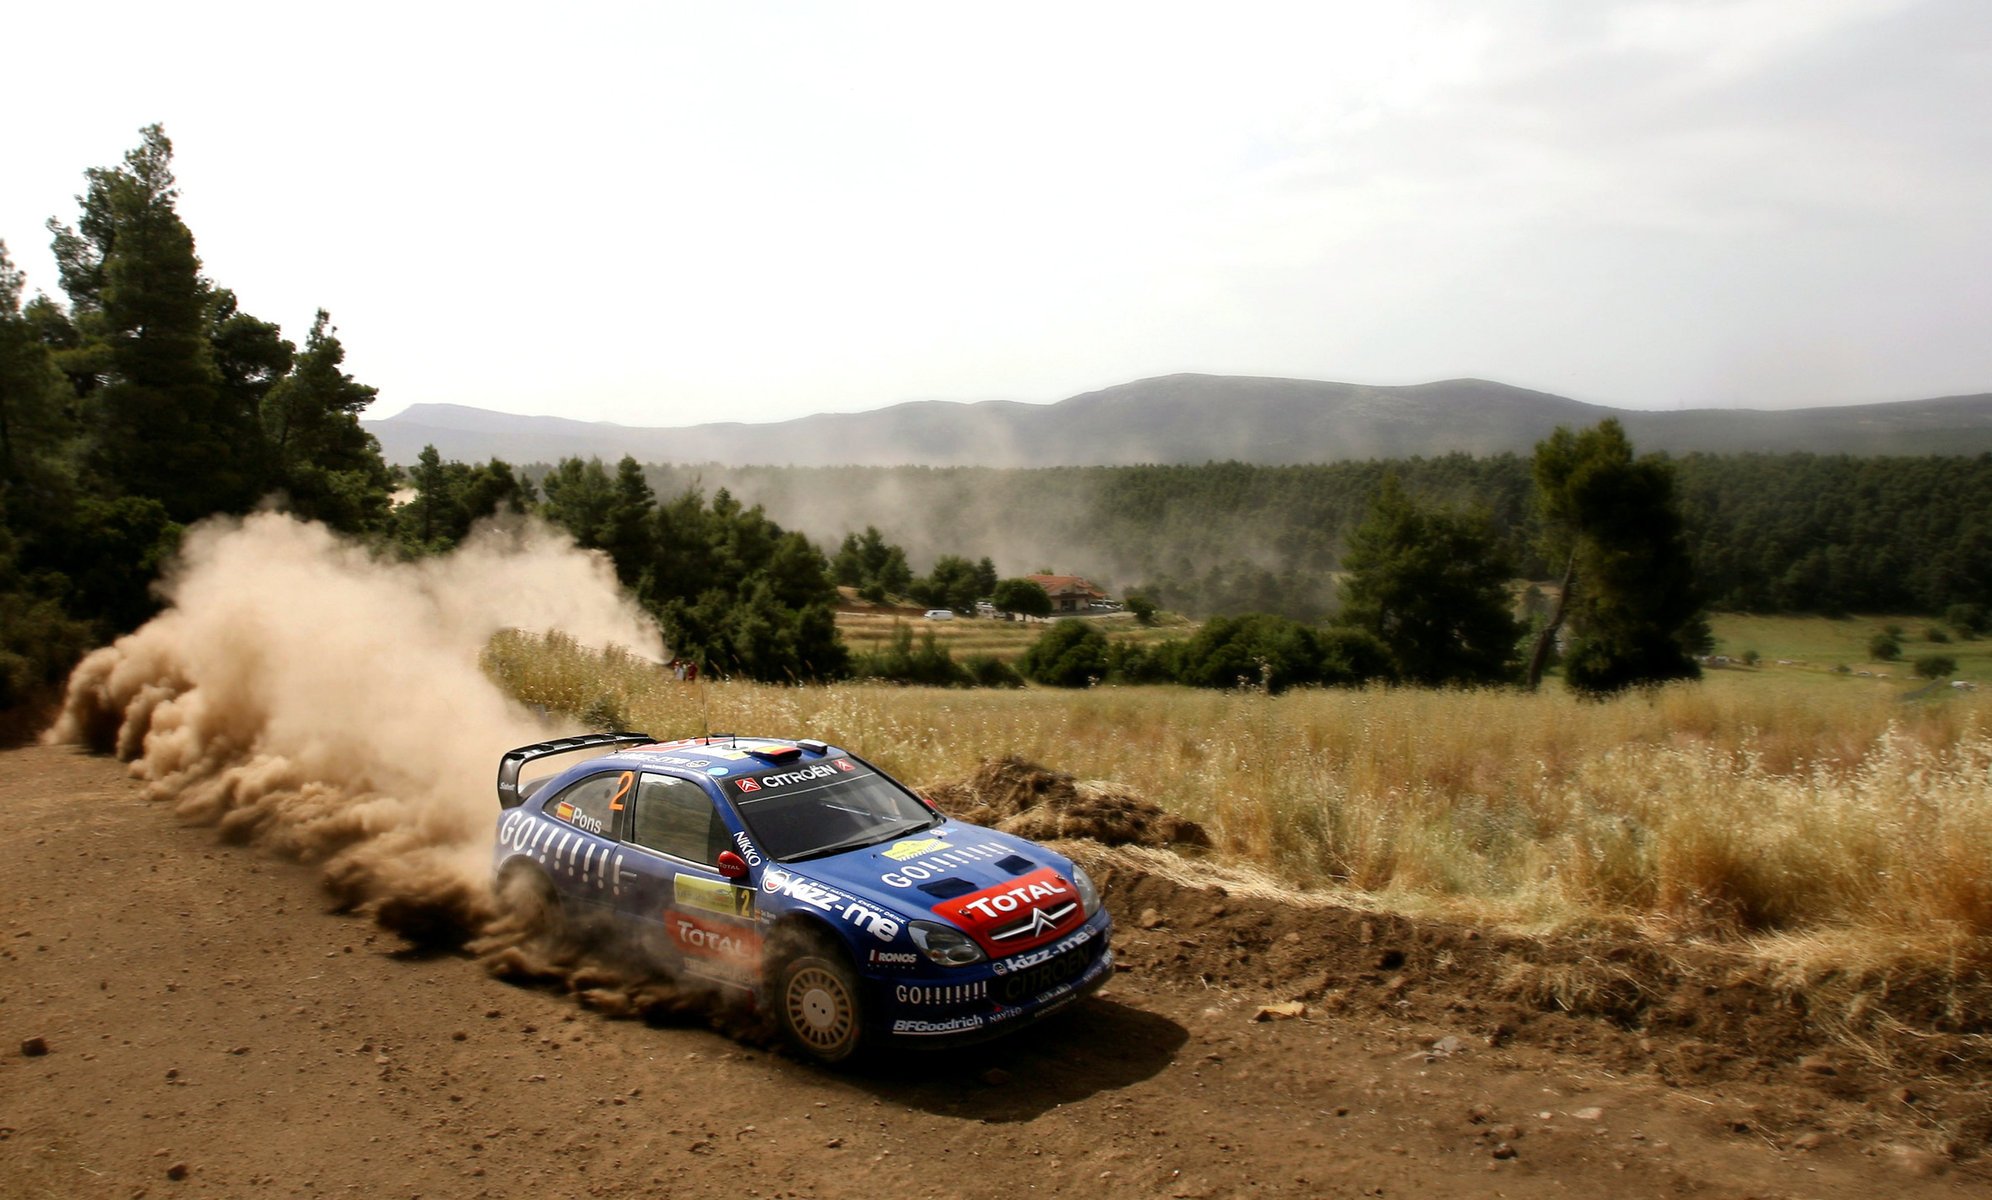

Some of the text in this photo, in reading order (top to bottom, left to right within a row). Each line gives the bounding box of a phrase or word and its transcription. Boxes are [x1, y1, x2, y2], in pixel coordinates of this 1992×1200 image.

[762, 764, 838, 788] CITROËN
[609, 771, 634, 811] 2
[572, 808, 602, 834] Pons
[733, 831, 761, 867] NIKKO
[719, 862, 740, 871] TOTAL
[741, 890, 750, 916] 2
[966, 881, 1066, 918] TOTAL
[677, 921, 742, 951] TOTAL
[1006, 932, 1090, 972] kizz-me
[893, 1014, 983, 1031] BFGoodrich
